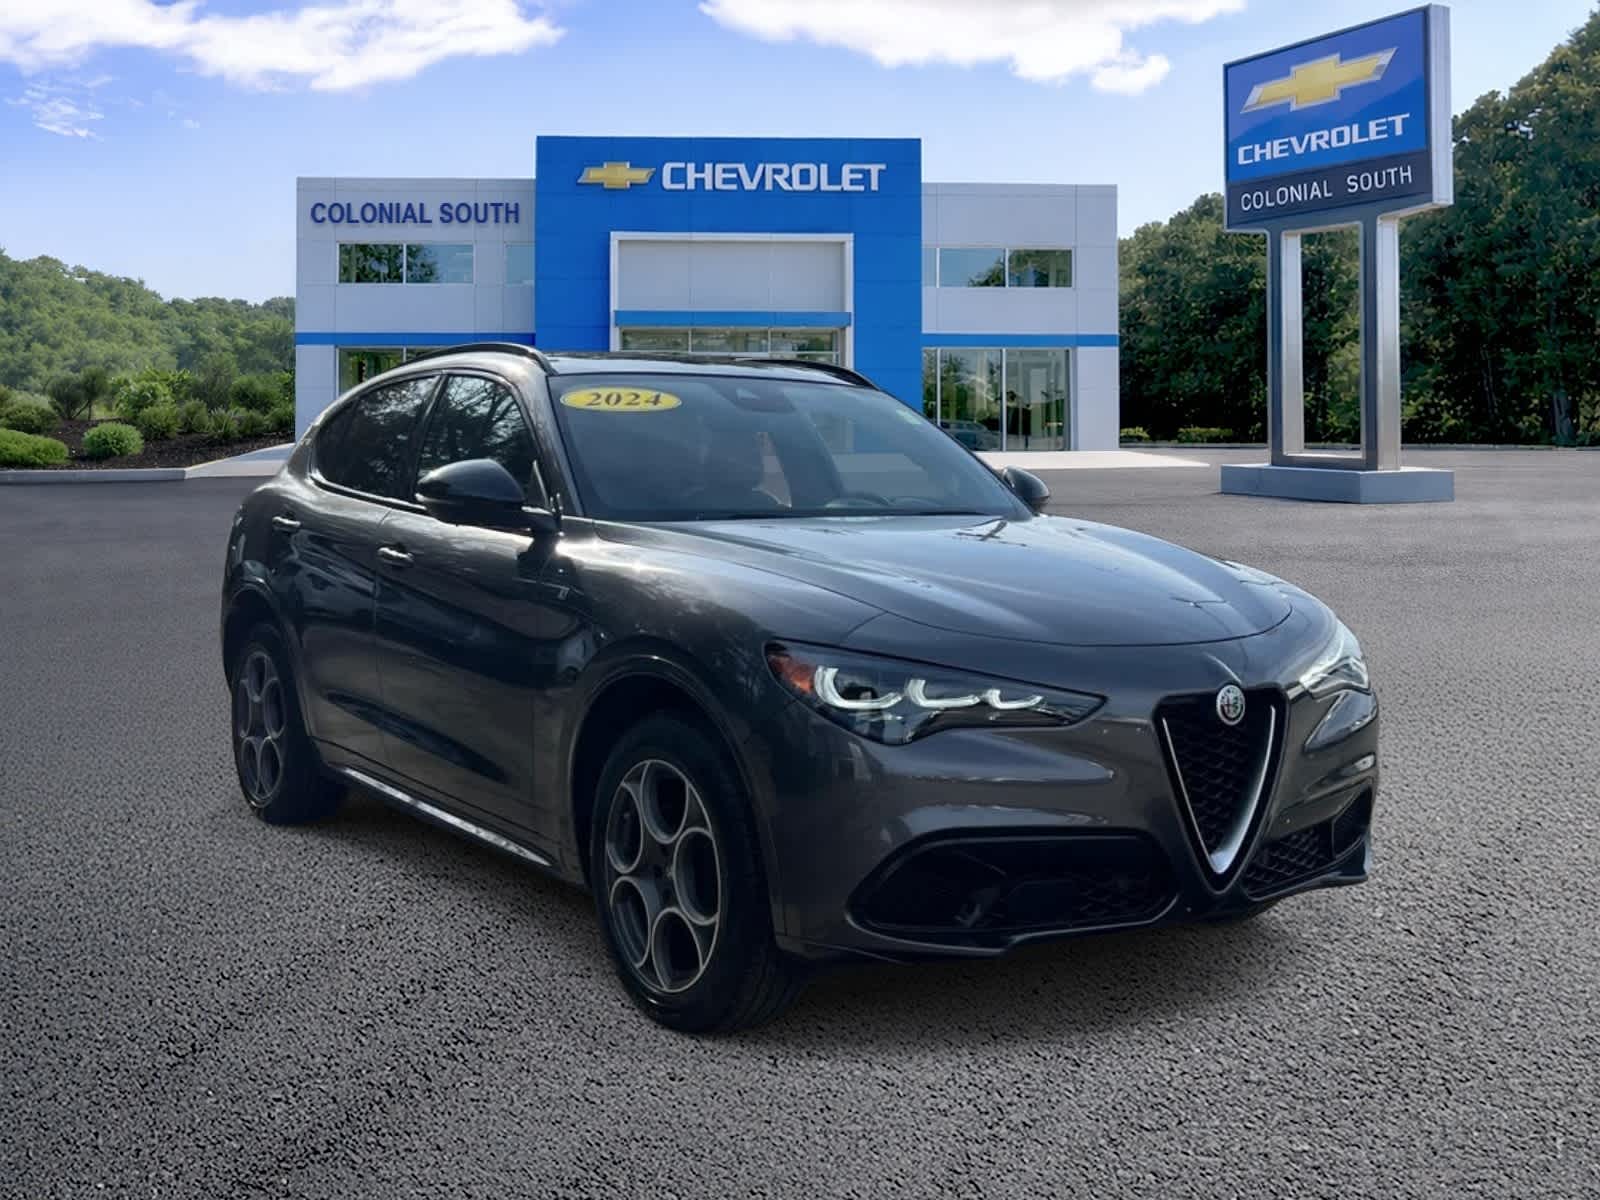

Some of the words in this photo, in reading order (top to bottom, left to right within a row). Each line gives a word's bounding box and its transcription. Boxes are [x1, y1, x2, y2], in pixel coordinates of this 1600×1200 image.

[1237, 113, 1410, 165] CHEVROLET
[661, 162, 887, 192] CHEVROLET
[1240, 180, 1333, 211] COLONIAL
[1346, 166, 1412, 193] SOUTH
[310, 202, 433, 224] COLONIAL
[439, 202, 520, 224] SOUTH
[585, 392, 663, 406] 2024
